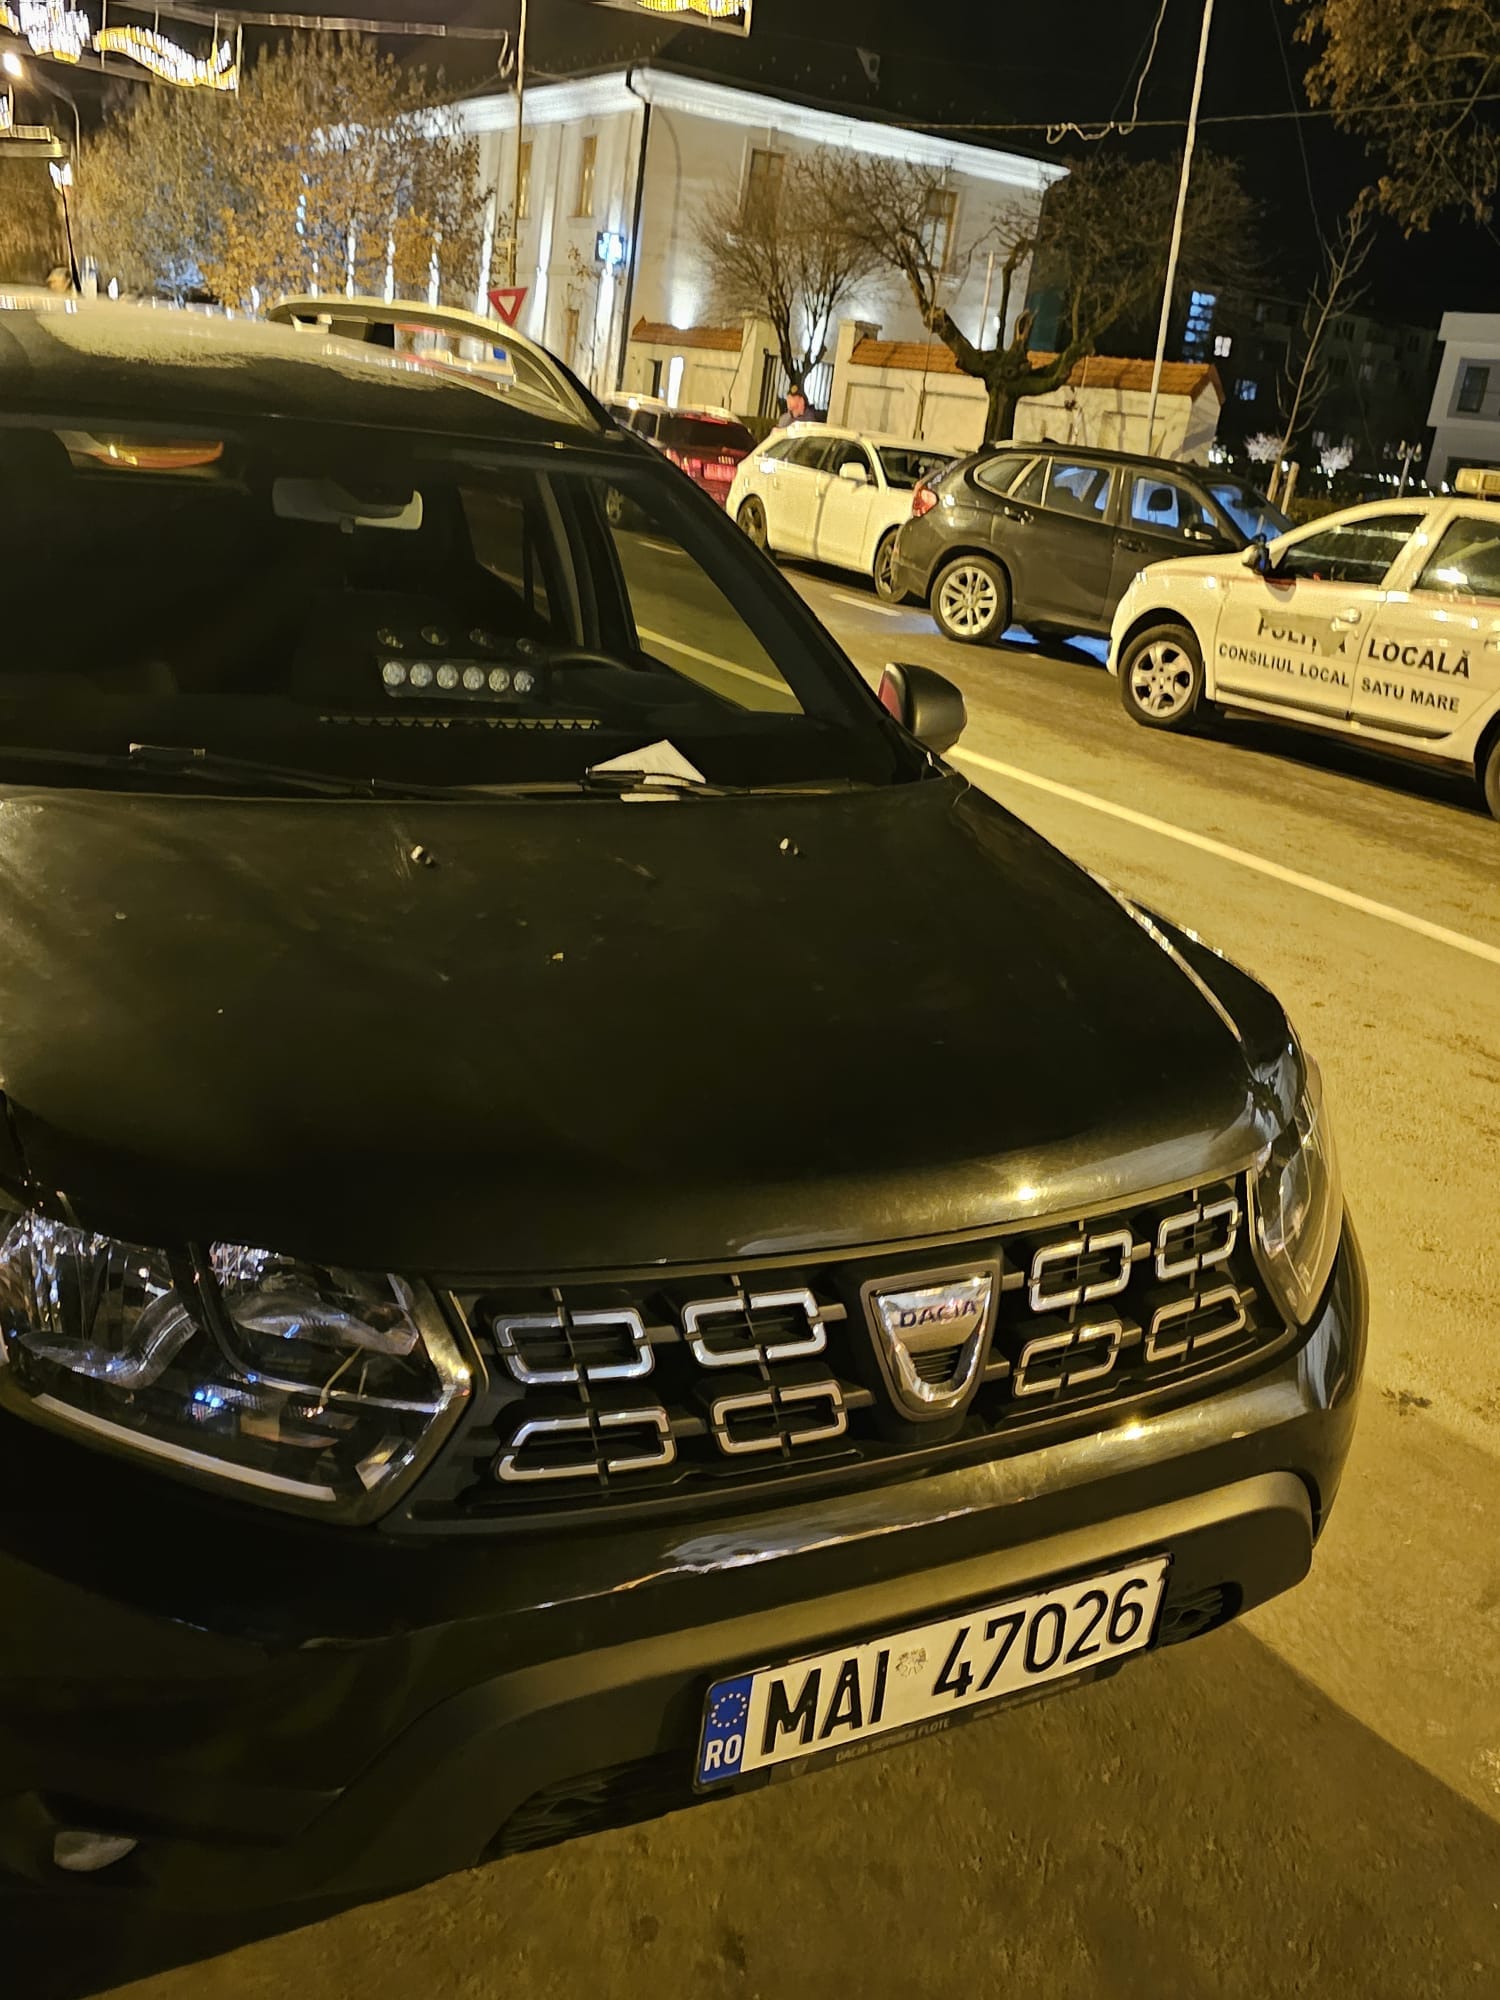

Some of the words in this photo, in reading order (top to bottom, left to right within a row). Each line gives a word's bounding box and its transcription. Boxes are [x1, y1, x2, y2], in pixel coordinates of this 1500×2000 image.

[1219, 642, 1295, 674] CONSILIUL
[1300, 662, 1350, 688] LOCAL
[1361, 676, 1405, 701] SATU
[1410, 690, 1460, 714] MARE
[1368, 638, 1470, 679] LOCALĂ
[900, 1300, 977, 1328] DACIA
[704, 1733, 742, 1772] RO
[761, 1650, 890, 1756] MAI
[932, 1579, 1148, 1698] 47026
